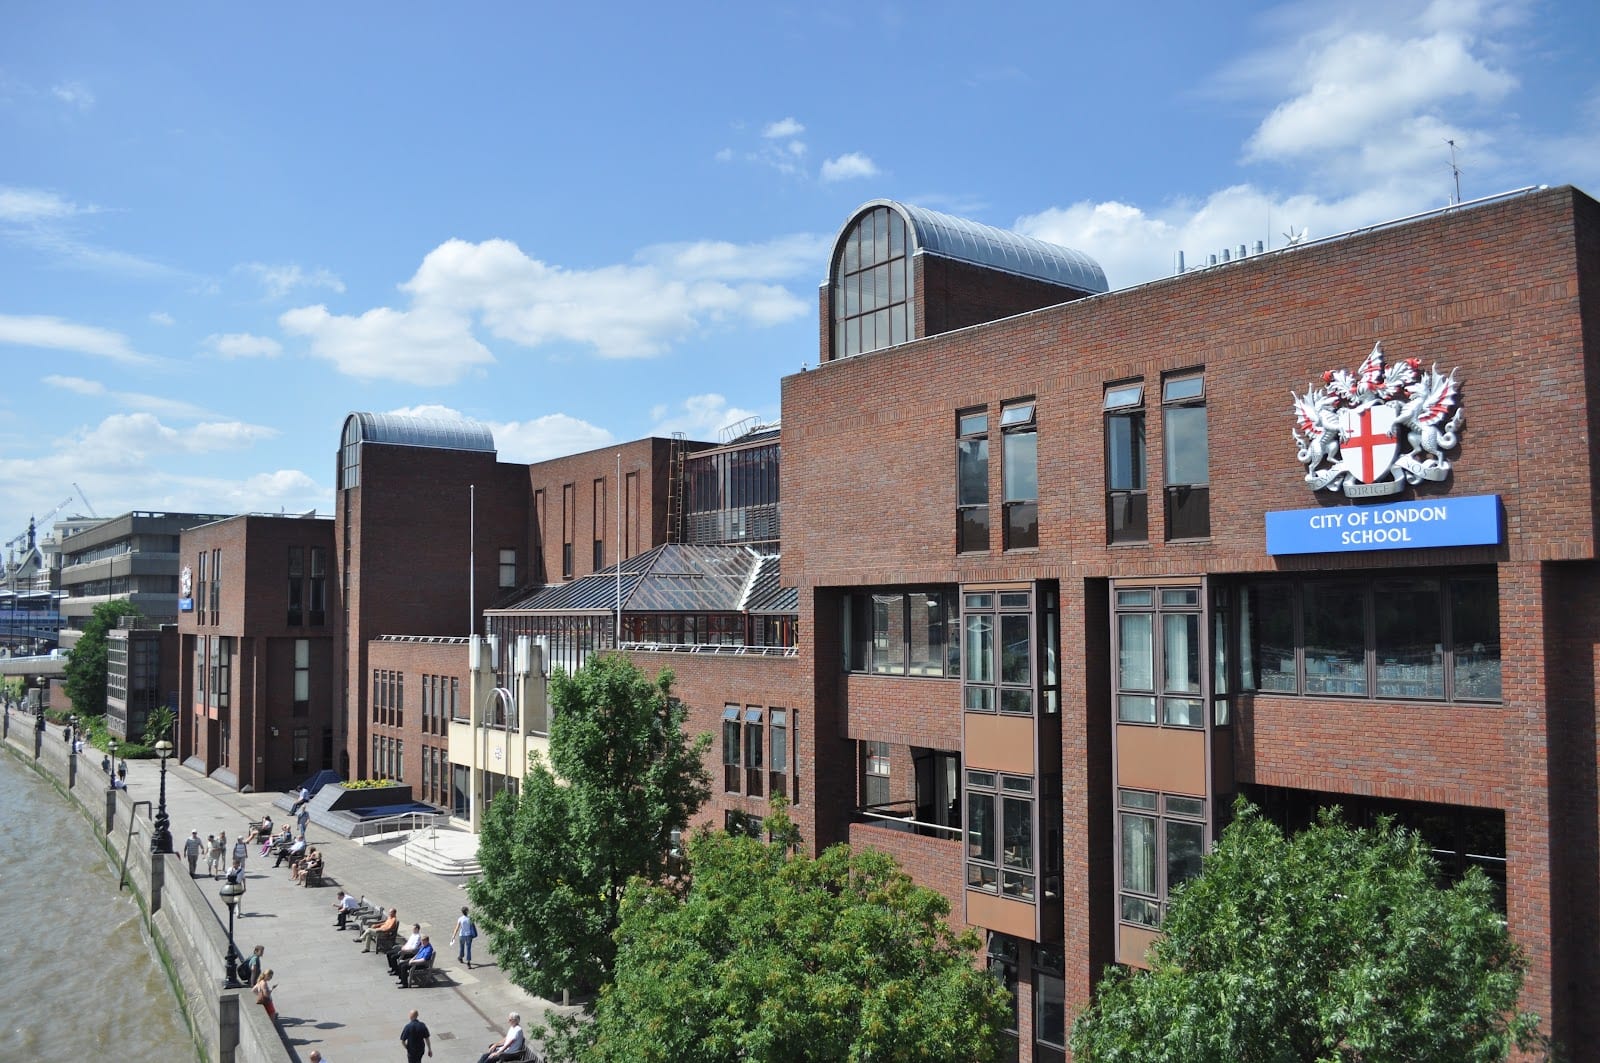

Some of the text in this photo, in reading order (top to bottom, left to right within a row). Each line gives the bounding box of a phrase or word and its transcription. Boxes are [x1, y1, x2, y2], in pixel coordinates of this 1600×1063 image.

[1348, 484, 1389, 497] DIRIGE
[1309, 507, 1447, 529] CITY OF LONDON
[1341, 528, 1411, 545] SCHOOL
